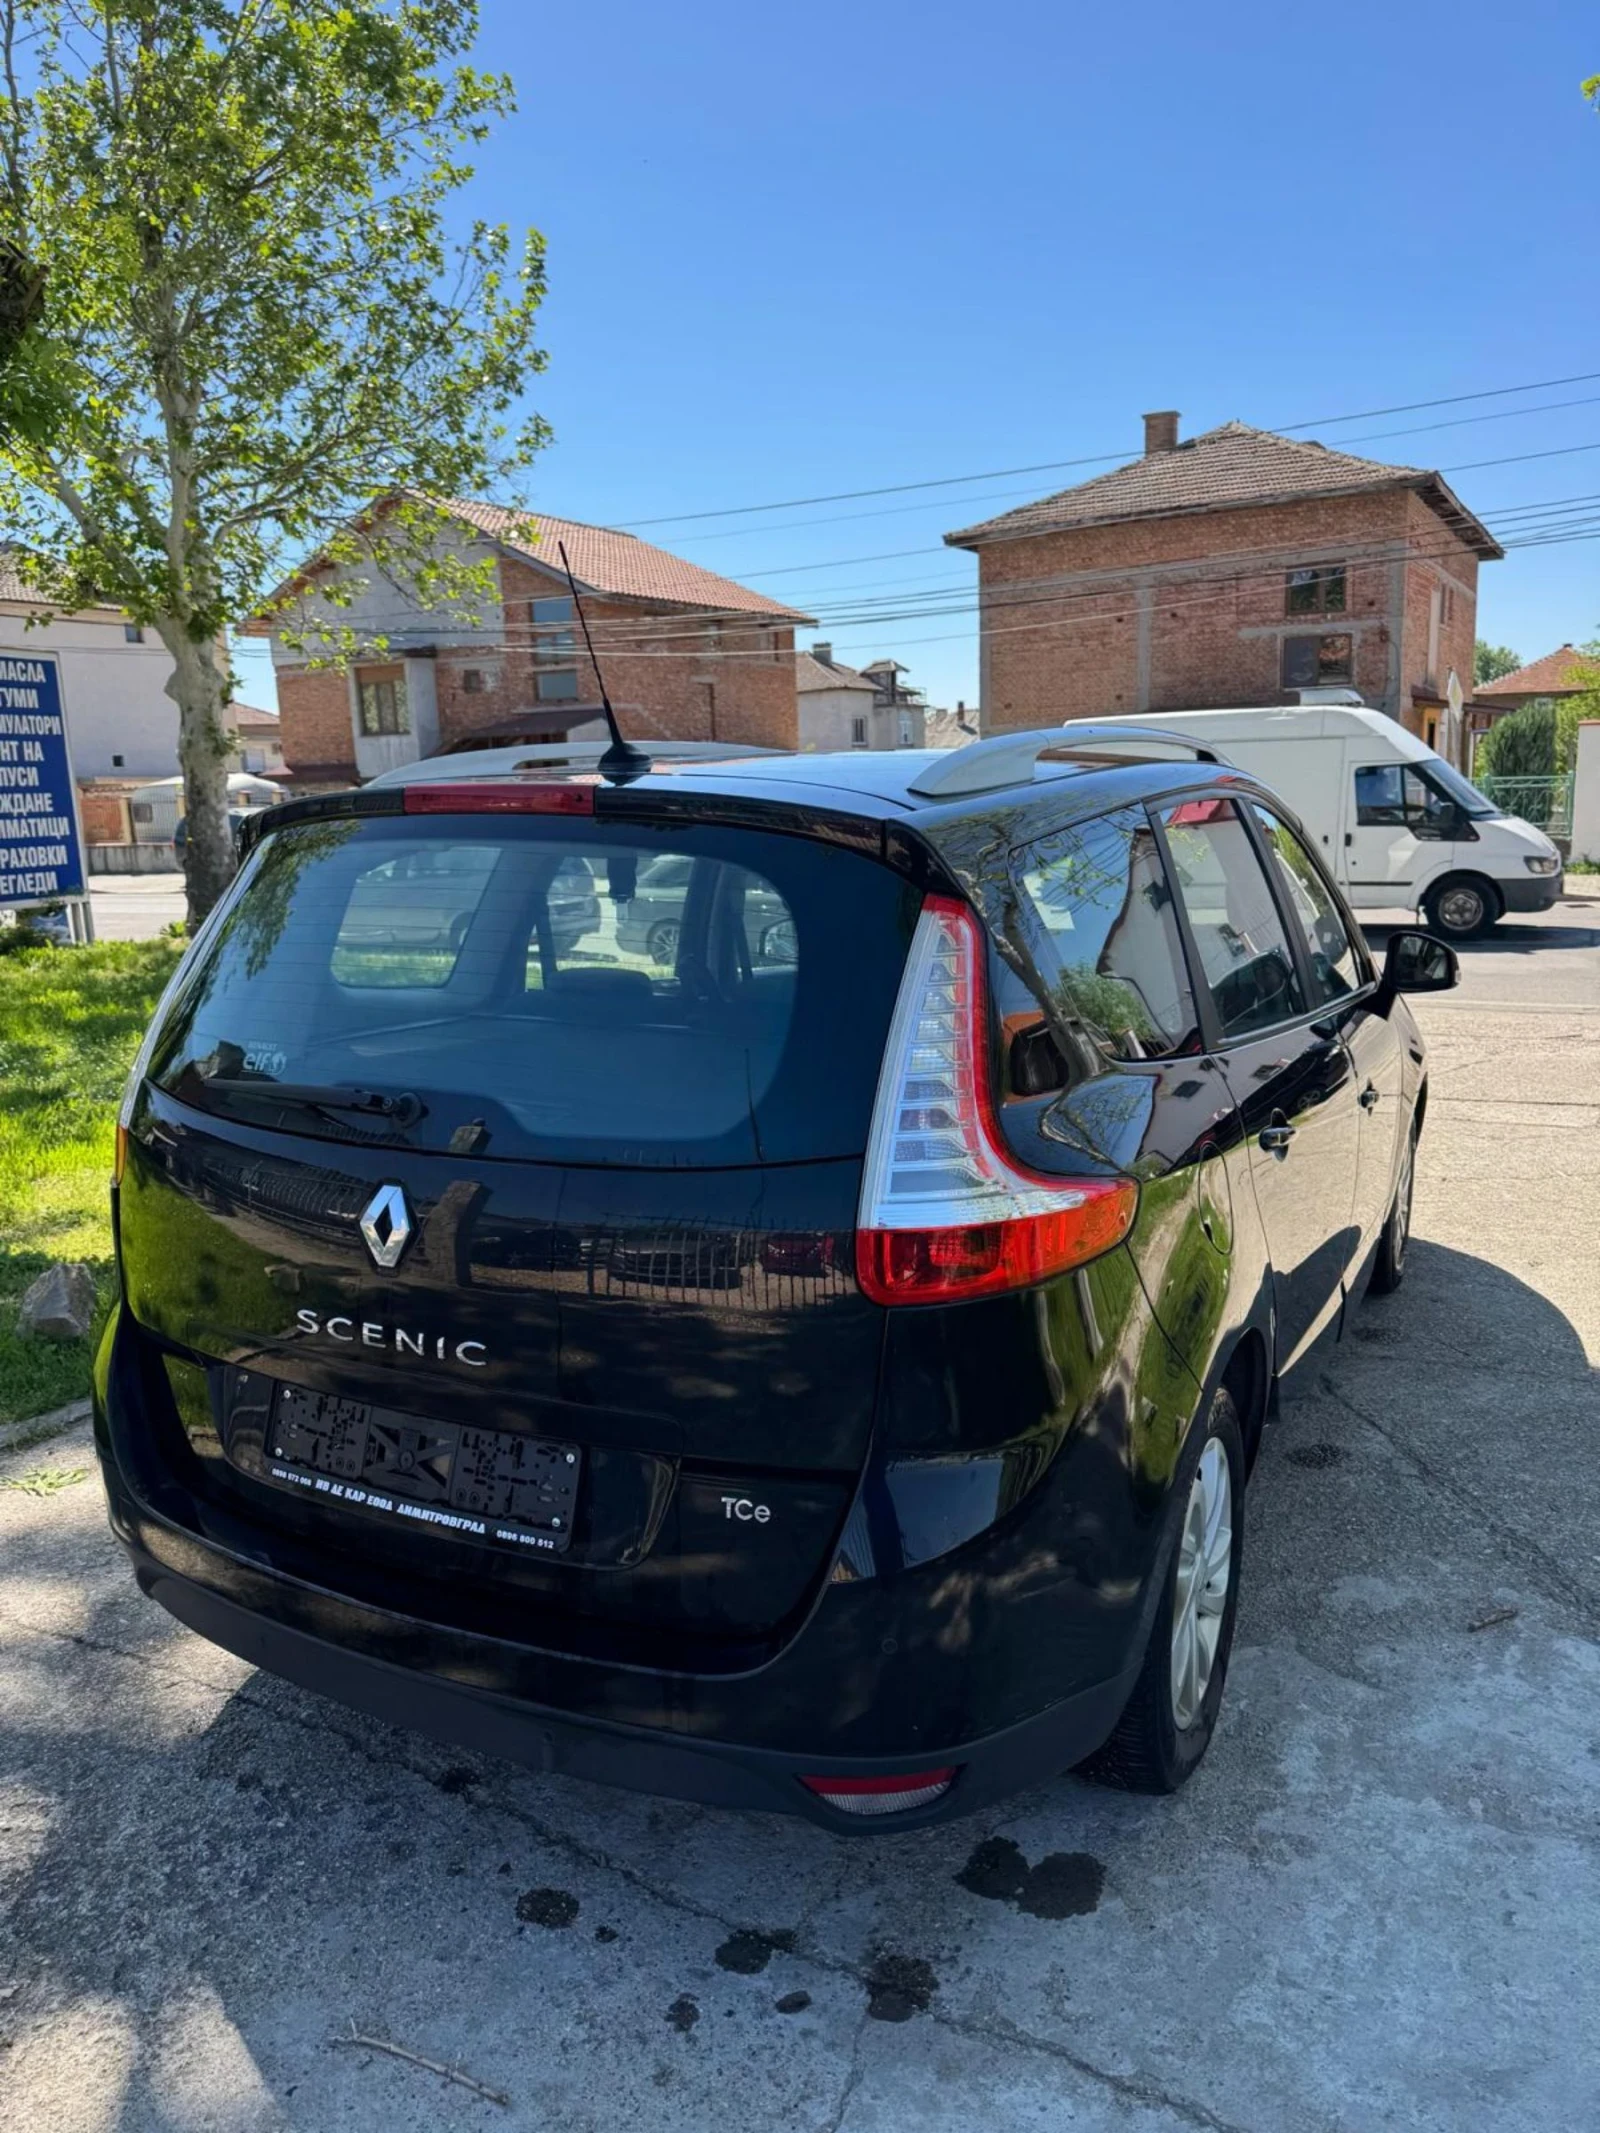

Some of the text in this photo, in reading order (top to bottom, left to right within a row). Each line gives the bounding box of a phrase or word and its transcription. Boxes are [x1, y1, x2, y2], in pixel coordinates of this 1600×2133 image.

[22, 740, 45, 762] НА
[0, 844, 68, 869] РАХОВКИ
[0, 871, 58, 895] ЕГЛЕДИ
[242, 1052, 271, 1071] elf
[296, 1309, 488, 1366] SCENIC
[344, 1487, 366, 1502] КАР
[366, 1494, 393, 1511] ЕООД
[396, 1503, 486, 1534] ДИМИТРОВГРАД
[721, 1496, 771, 1523] TCe
